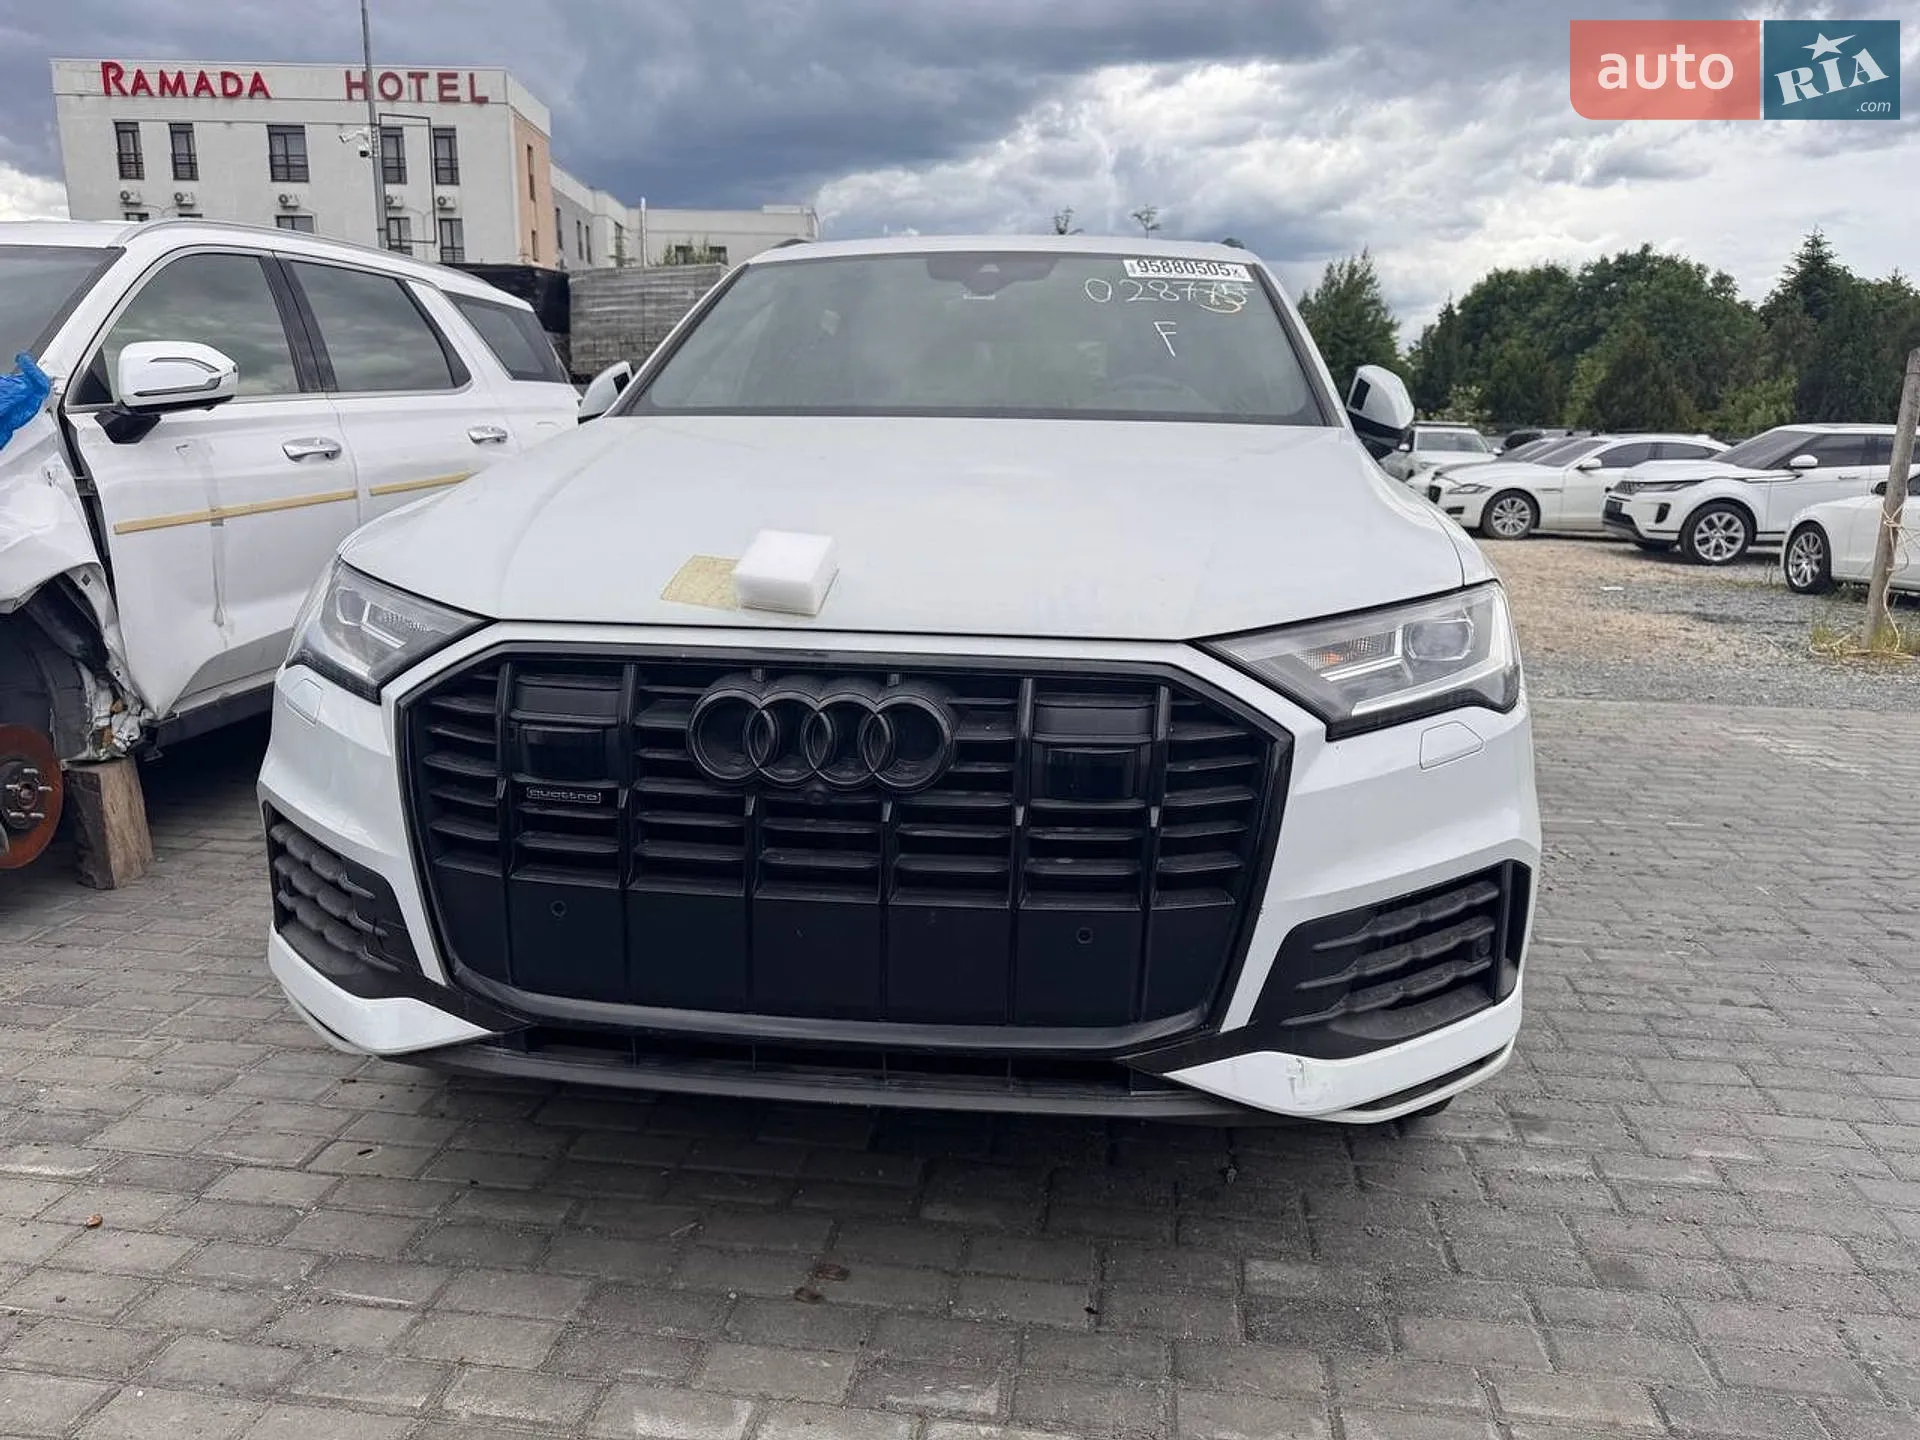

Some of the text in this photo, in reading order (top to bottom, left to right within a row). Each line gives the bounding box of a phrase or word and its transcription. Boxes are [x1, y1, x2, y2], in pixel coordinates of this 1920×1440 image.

[100, 61, 490, 104] RAMADA HOTEL
[1153, 321, 1178, 358] F
[528, 788, 598, 802] quattro
